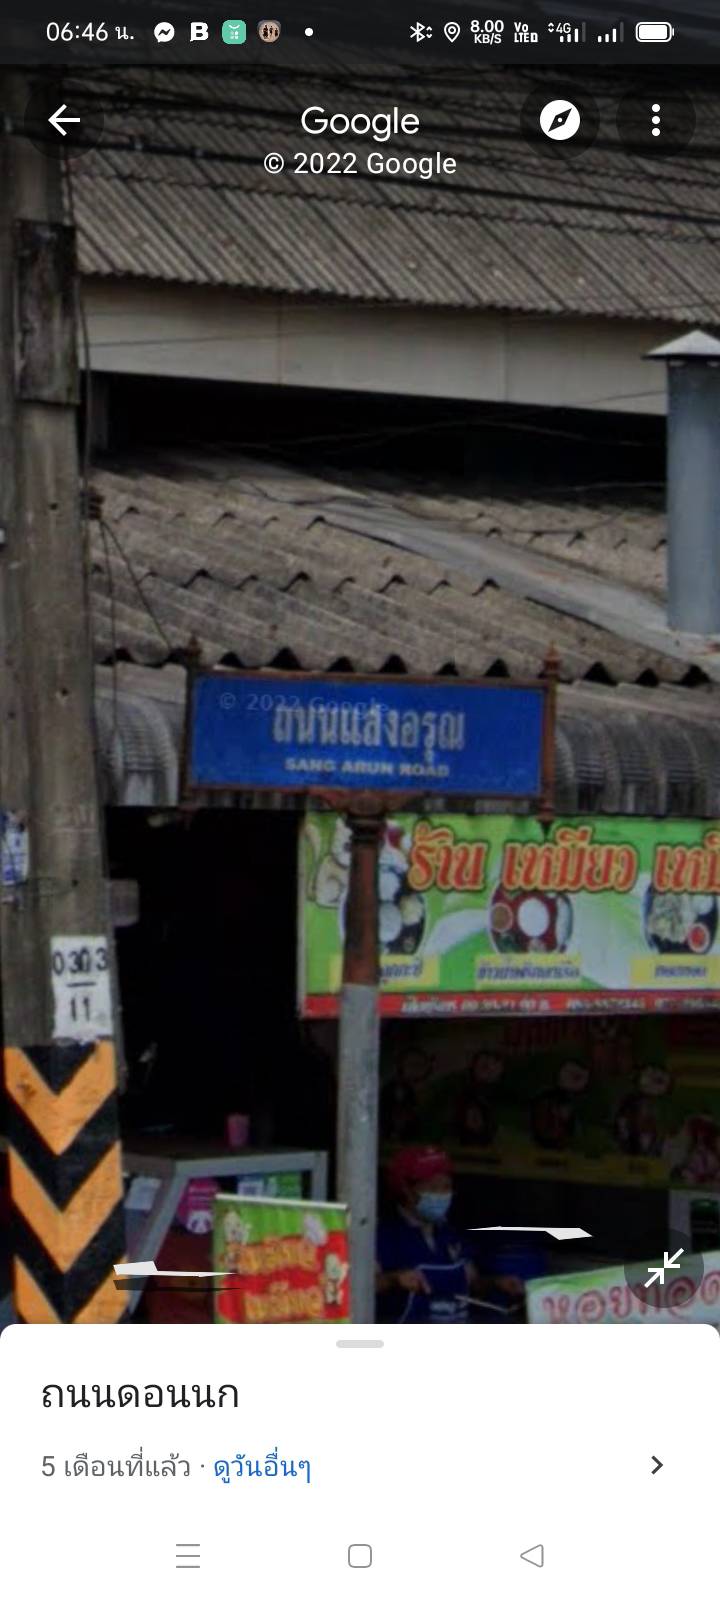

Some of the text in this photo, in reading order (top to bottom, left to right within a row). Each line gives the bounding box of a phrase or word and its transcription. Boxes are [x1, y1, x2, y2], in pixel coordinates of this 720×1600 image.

[272, 700, 466, 763] ถนนแสงอรุณ
[285, 757, 449, 778] SANG ARUN ROAD
[408, 824, 487, 891] ร้าน
[502, 825, 638, 892] เหมียว
[69, 996, 91, 1022] 11
